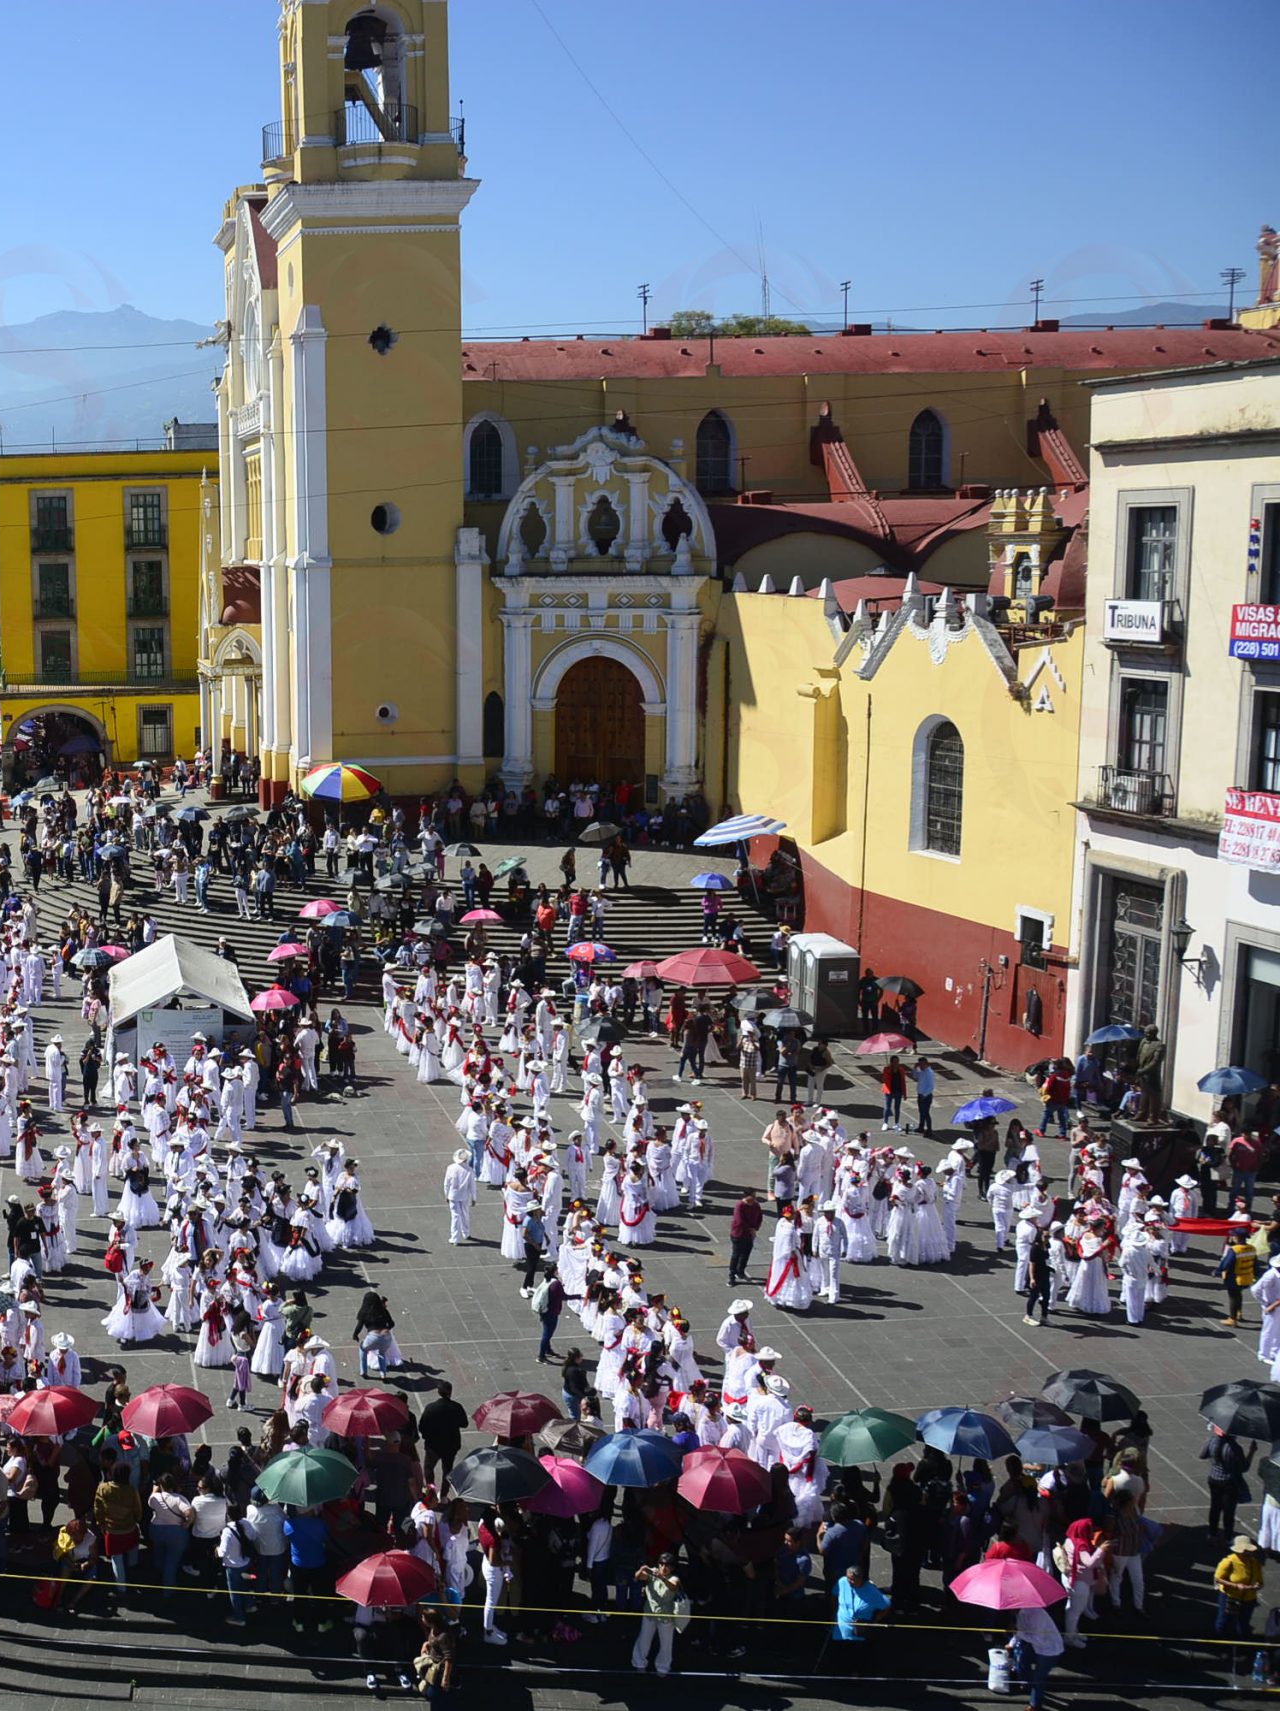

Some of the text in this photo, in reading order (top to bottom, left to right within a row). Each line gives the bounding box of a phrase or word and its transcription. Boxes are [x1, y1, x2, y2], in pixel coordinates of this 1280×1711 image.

[1108, 605, 1156, 630] TRIBUNA
[1237, 606, 1275, 622] VISAS
[1233, 640, 1279, 658] (228) 501
